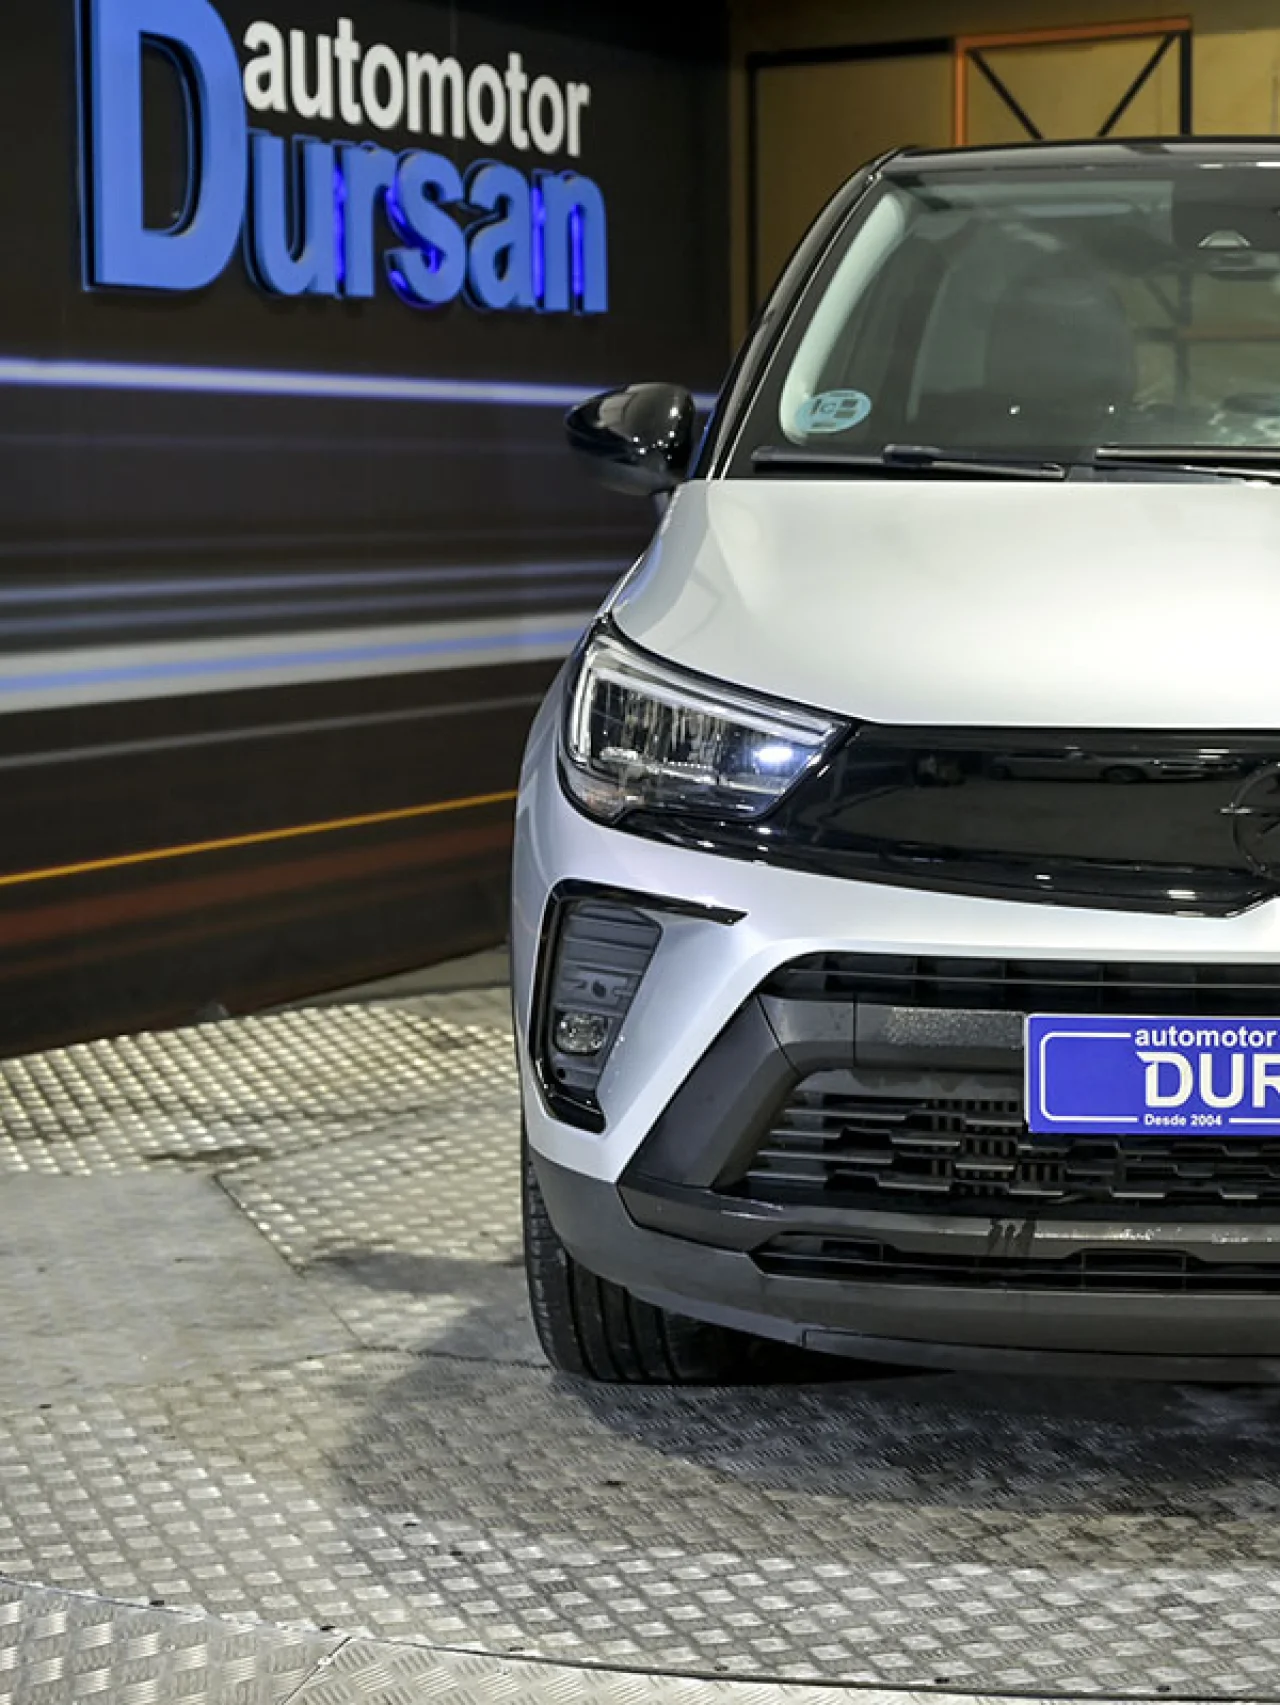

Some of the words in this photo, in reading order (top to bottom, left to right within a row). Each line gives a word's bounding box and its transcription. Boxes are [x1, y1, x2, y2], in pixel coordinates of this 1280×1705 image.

[243, 17, 591, 157] automotor
[76, 0, 608, 315] Dursan
[1135, 1025, 1277, 1047] automotor
[1144, 1113, 1187, 1126] Desde
[1190, 1113, 1222, 1126] 2004
